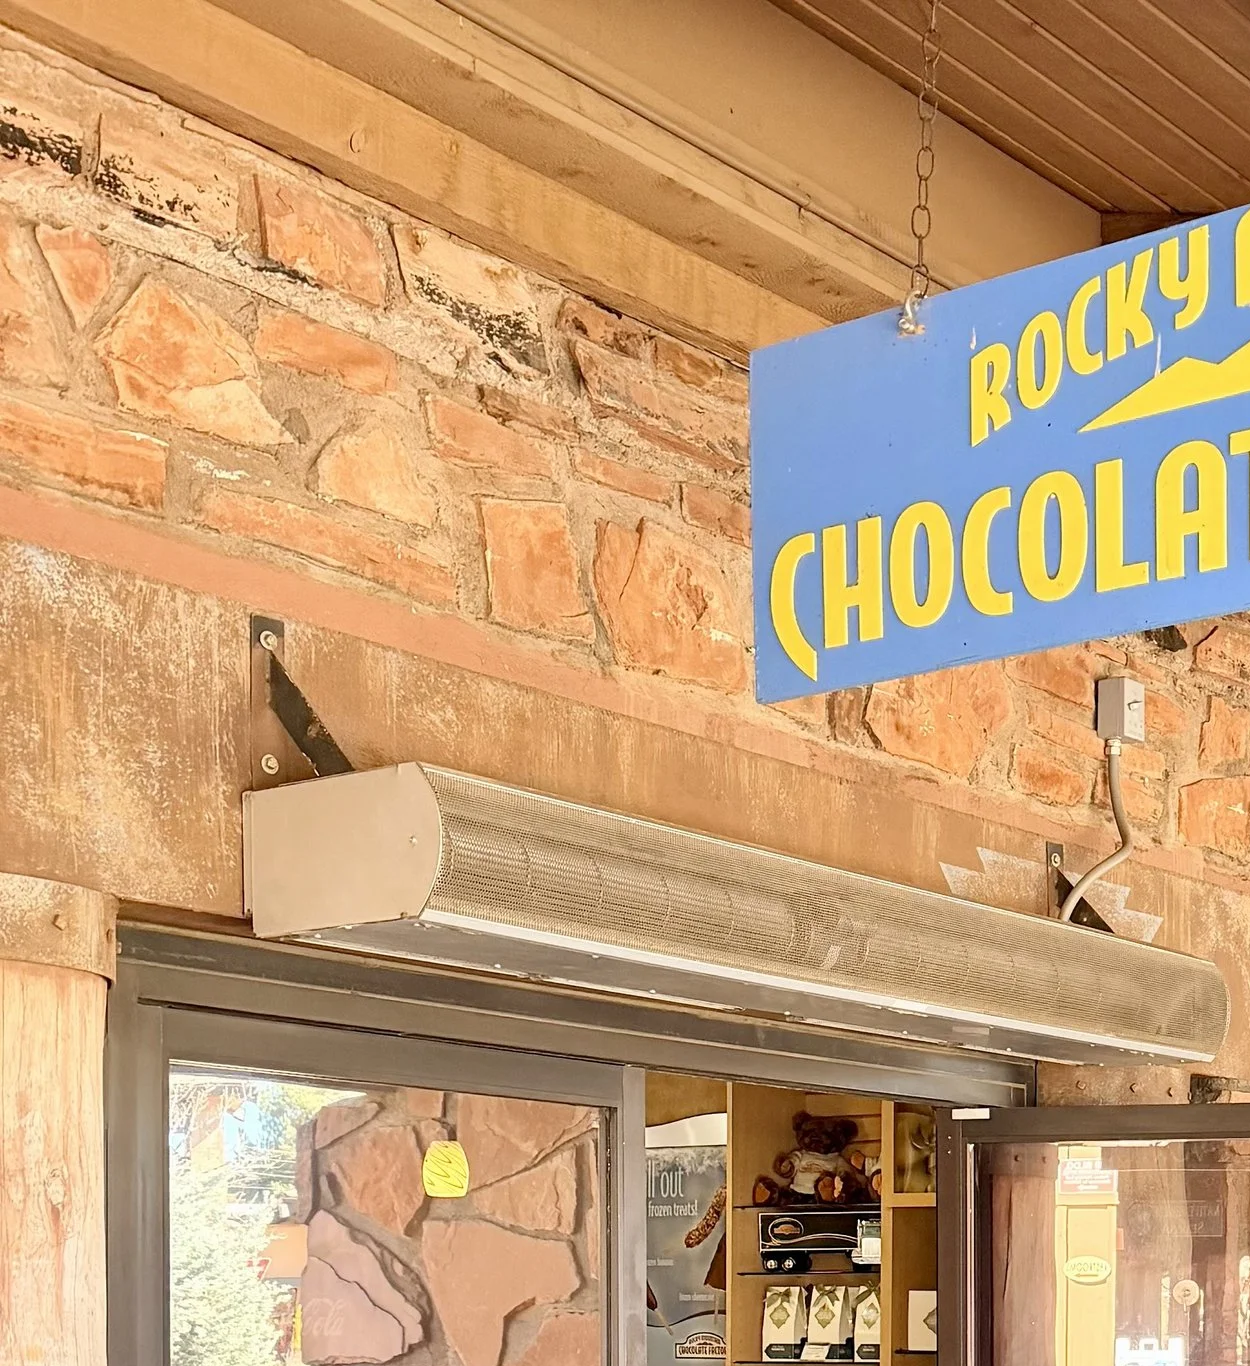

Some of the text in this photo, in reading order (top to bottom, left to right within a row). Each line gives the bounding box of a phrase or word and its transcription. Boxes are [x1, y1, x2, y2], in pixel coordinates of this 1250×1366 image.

[970, 226, 1210, 444] ROCKY
[660, 1166, 684, 1198] out
[648, 1200, 672, 1217] frozen
